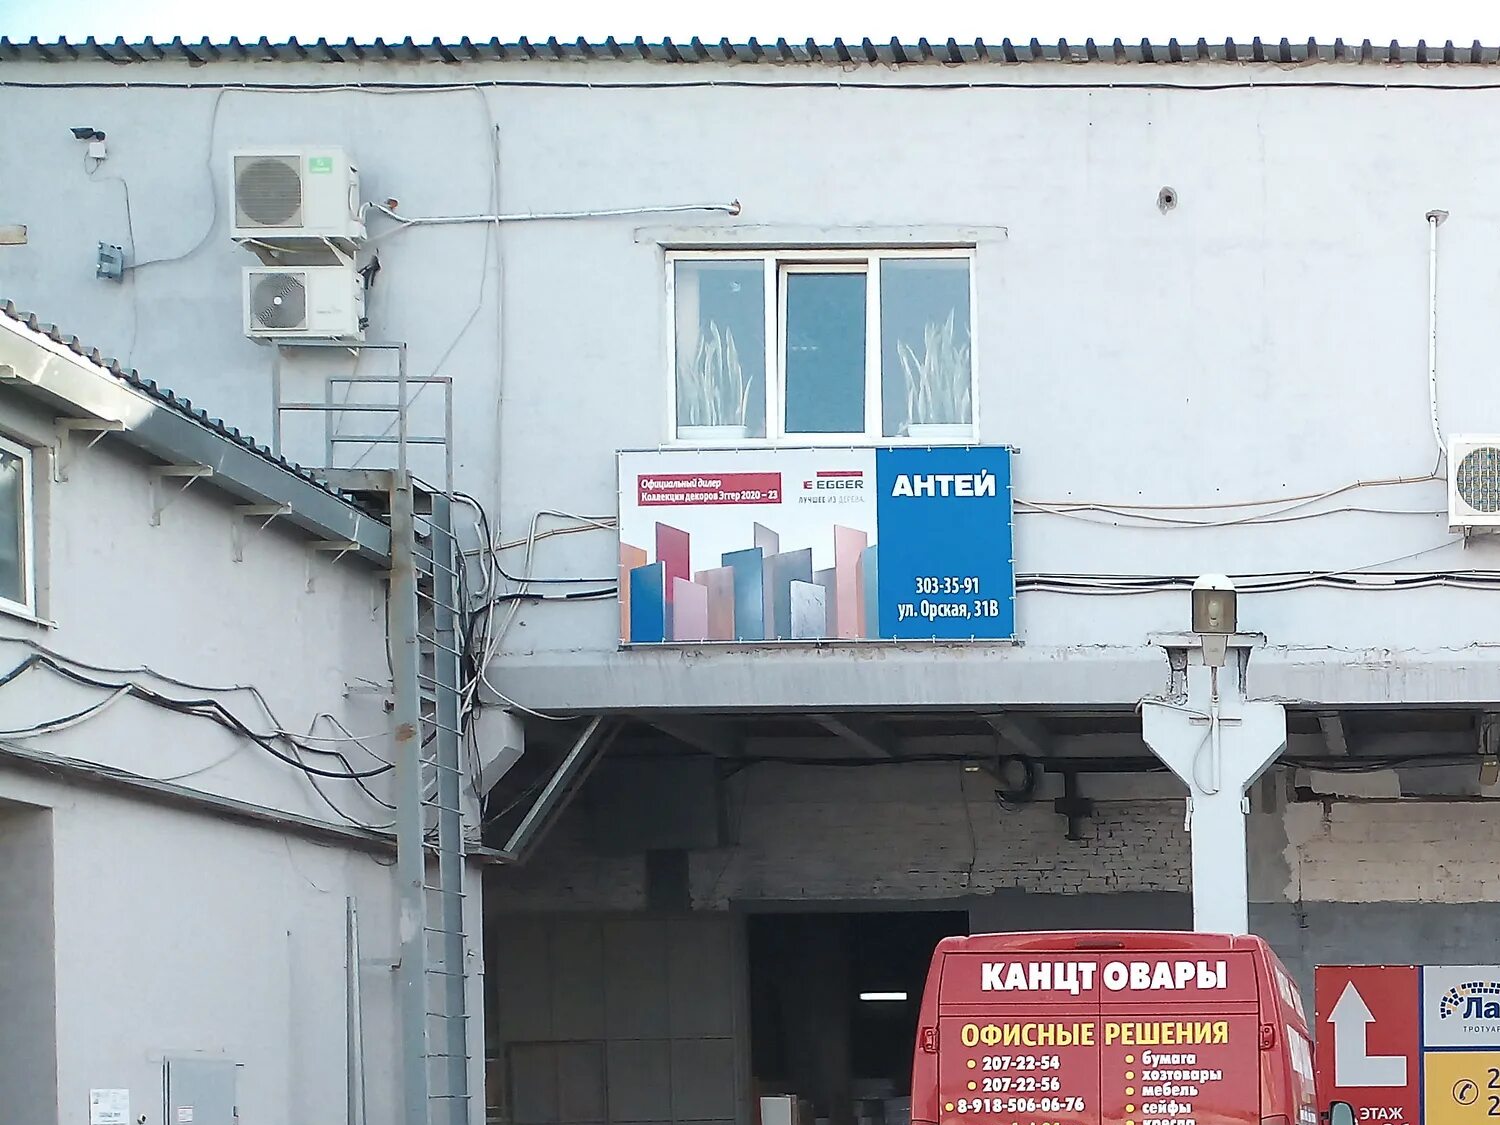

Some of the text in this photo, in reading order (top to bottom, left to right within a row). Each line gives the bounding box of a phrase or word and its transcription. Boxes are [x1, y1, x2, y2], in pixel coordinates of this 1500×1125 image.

[641, 478, 721, 490] Официальный дилер
[817, 479, 864, 489] EGGER
[891, 469, 996, 497] АНТЕЙ
[741, 490, 760, 500] 2020
[768, 490, 778, 500] 23
[915, 577, 980, 594] 303-35-91
[898, 600, 999, 622] ул. Орская, 31В
[961, 1021, 1228, 1047] ОФИСНЫЕ РЕШЕНИЯ
[982, 1055, 1061, 1071] 207-22-54
[1141, 1050, 1197, 1067] бумага
[1141, 1069, 1222, 1083] хозтовары
[982, 1077, 1061, 1092] 207-22-56
[1141, 1083, 1199, 1097] мебель
[957, 1096, 1085, 1113] 8-918-506-06-76
[1141, 1100, 1192, 1117] сейфы
[1359, 1107, 1403, 1120] ЭТАЖ
